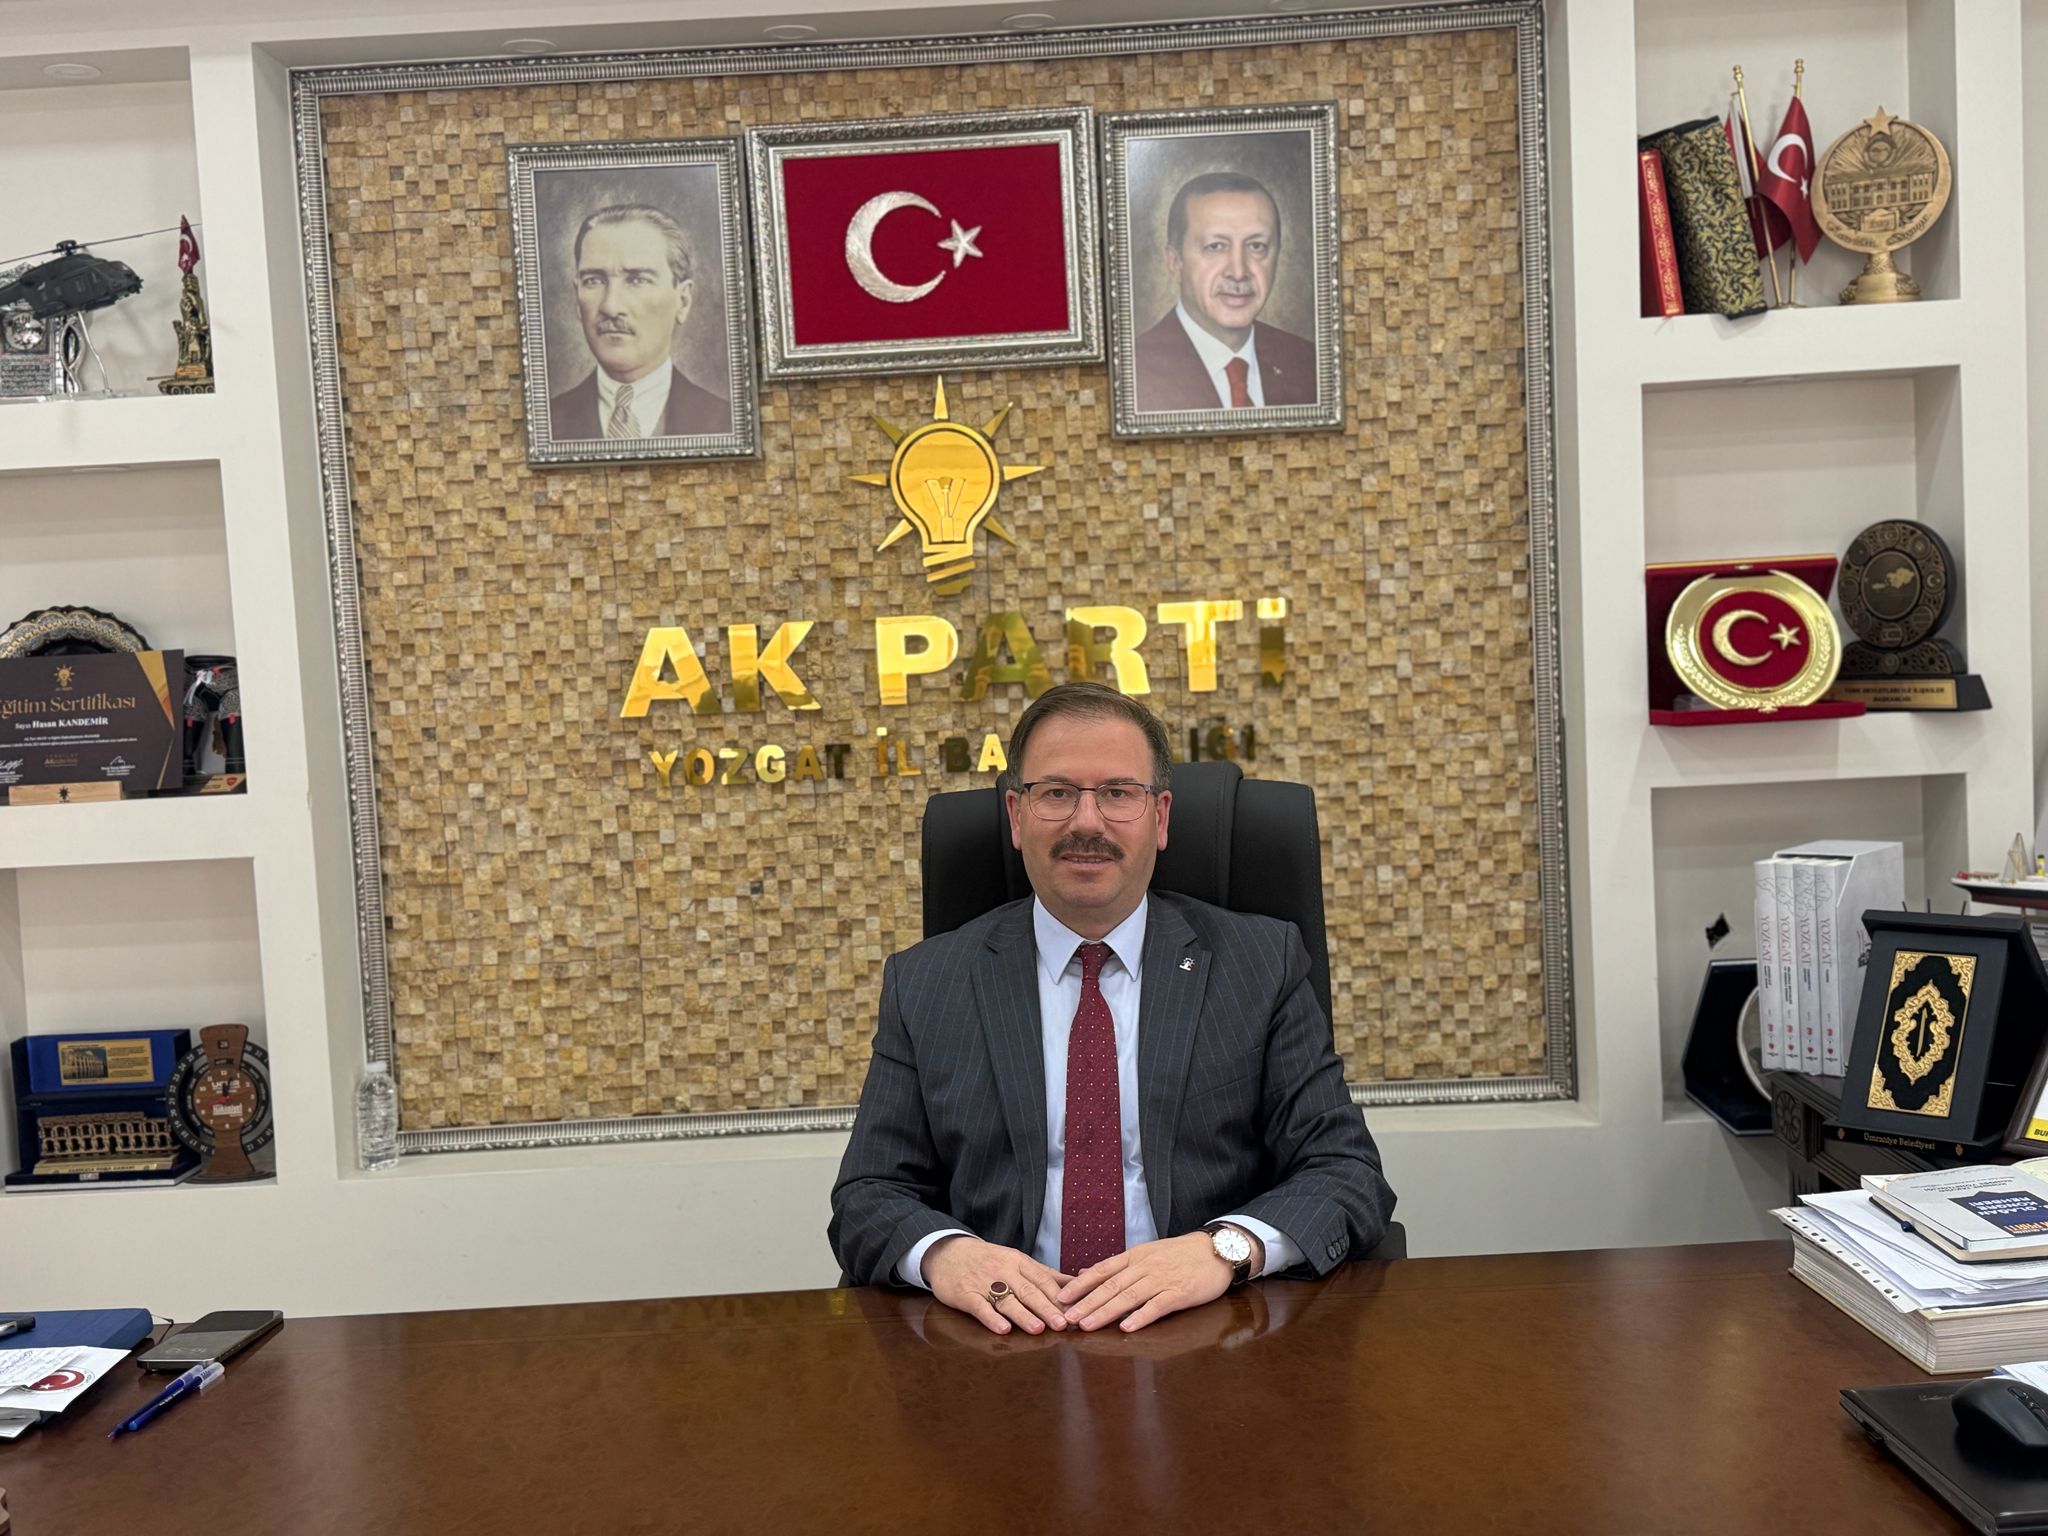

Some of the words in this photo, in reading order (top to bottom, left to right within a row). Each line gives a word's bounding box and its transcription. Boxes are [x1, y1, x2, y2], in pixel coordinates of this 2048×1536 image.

[620, 620, 822, 717] AK
[875, 597, 1288, 705] PARTİ
[32, 720, 57, 729] Hasan
[58, 716, 109, 728] KANDEMİR
[49, 693, 136, 713] Sertifikası
[650, 744, 850, 786] YOZGAT
[876, 726, 921, 777] İL
[1760, 915, 1772, 964] YOZGAT
[1780, 915, 1792, 965] YOZGAT
[1800, 917, 1812, 967] YOZGAT
[1820, 918, 1833, 968] YOZGAT
[1863, 1131, 1898, 1146] Ümraniye
[1899, 1137, 1936, 1151] Belediyesi
[1977, 1201, 2039, 1211] KONGRE
